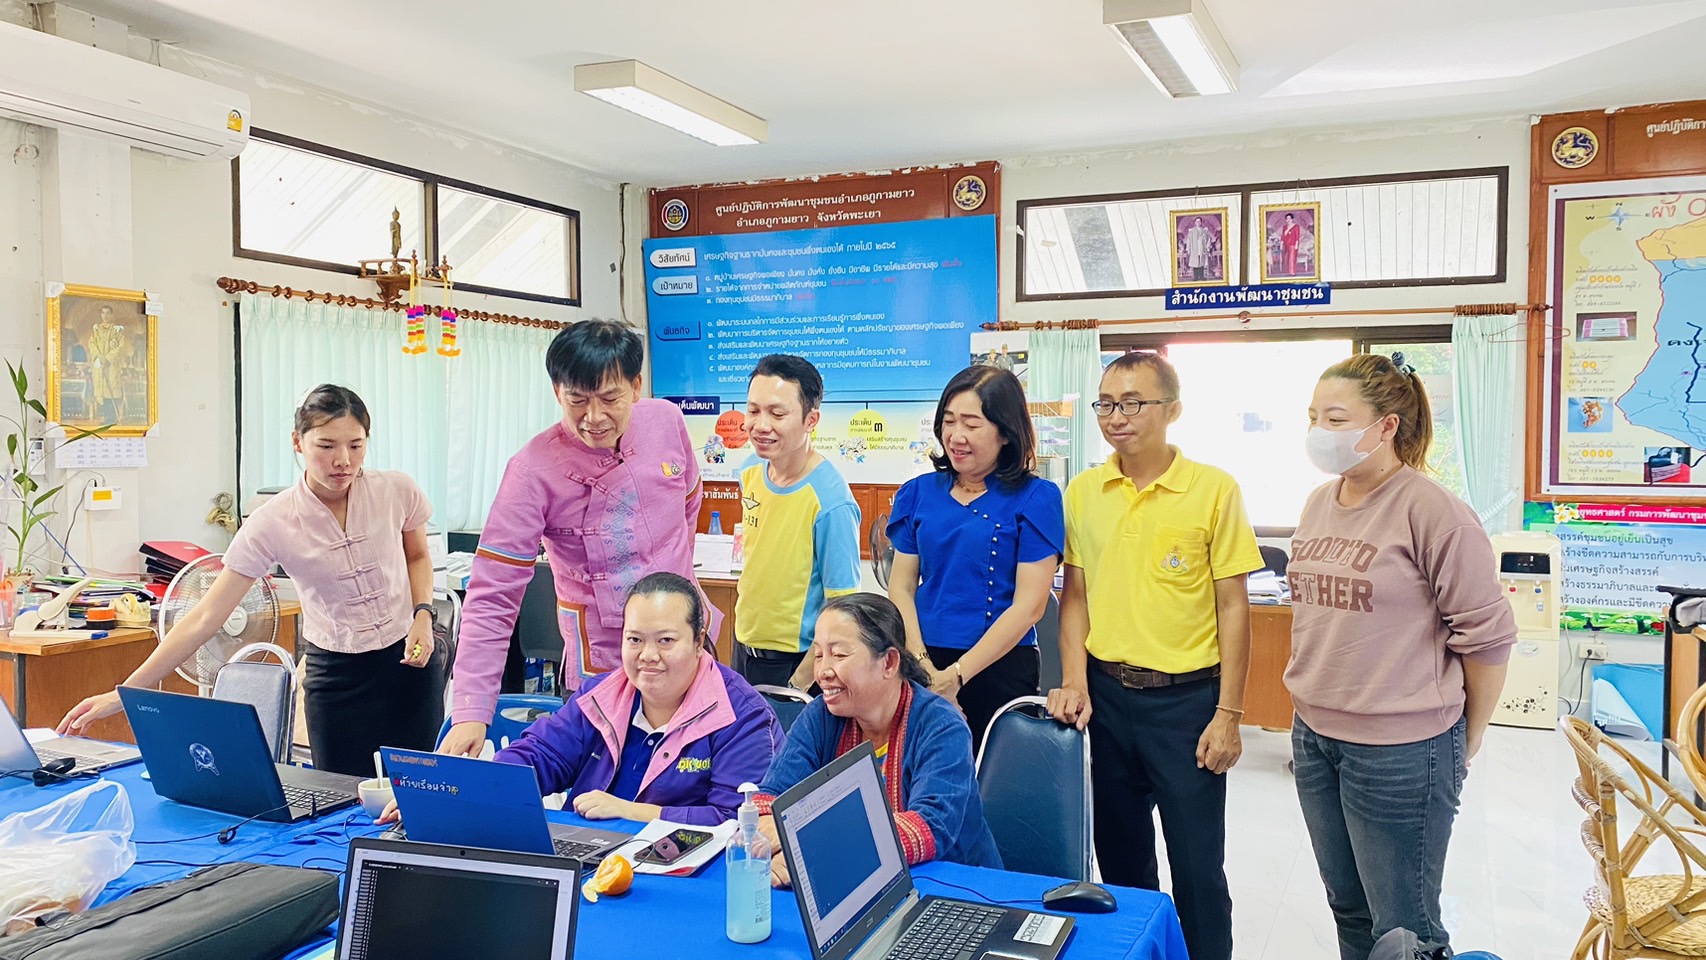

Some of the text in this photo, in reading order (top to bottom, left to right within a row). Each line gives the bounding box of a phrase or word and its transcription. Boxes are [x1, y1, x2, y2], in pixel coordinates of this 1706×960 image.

[715, 189, 915, 217] ศูนย์ปฏิบัติการพัฒนาชุมชนอำเภอภูกามยาว
[736, 209, 881, 229] อำเภอภูกามยาว จังหวัดพะเยา
[658, 252, 690, 264] วิสัยทัศน์
[660, 281, 693, 291] เป้าหมาย
[1171, 287, 1323, 306] สำนักงานพัฒนาชุมชน
[663, 326, 690, 335] พันธกิจ
[850, 418, 883, 432] ประเด็น ๓
[136, 704, 160, 713] Lenovo
